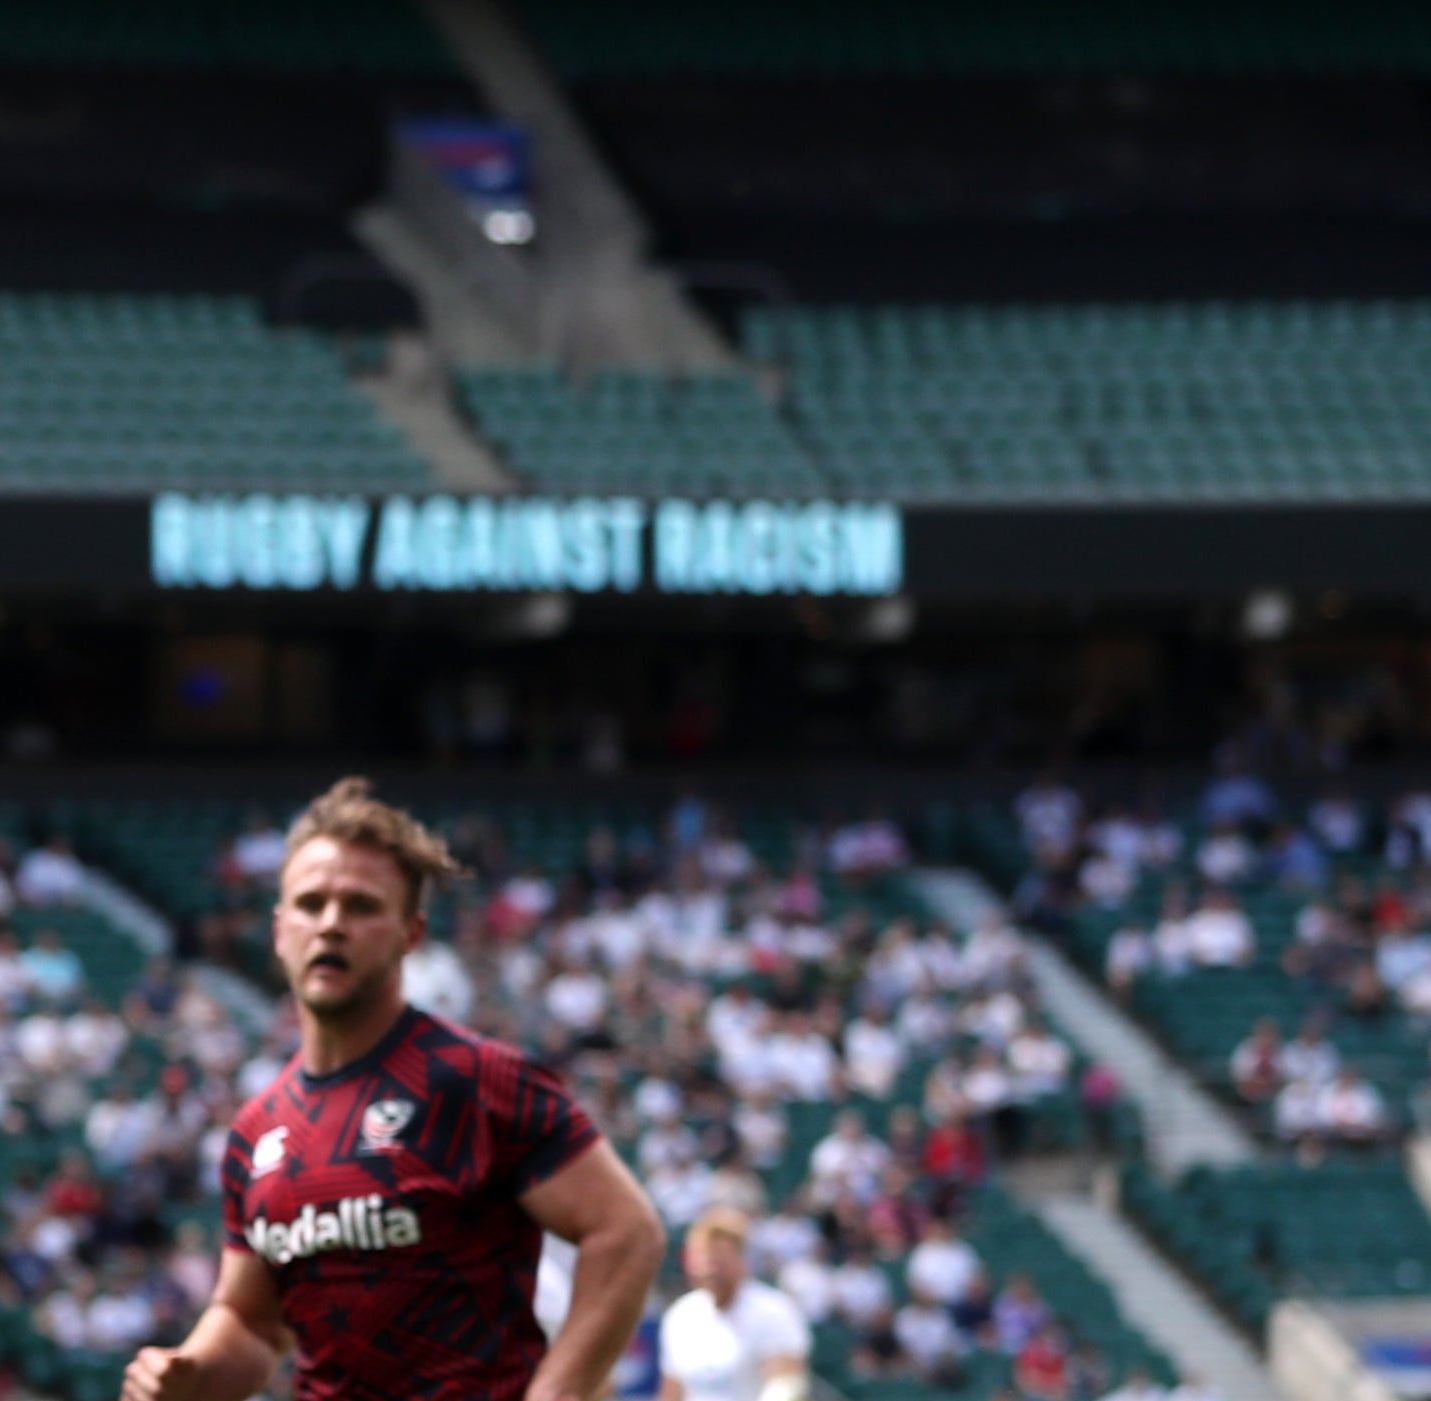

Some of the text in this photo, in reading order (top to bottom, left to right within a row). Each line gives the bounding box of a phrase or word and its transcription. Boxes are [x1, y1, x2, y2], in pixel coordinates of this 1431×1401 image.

[150, 493, 903, 595] RUGBY AGAINST RACISM
